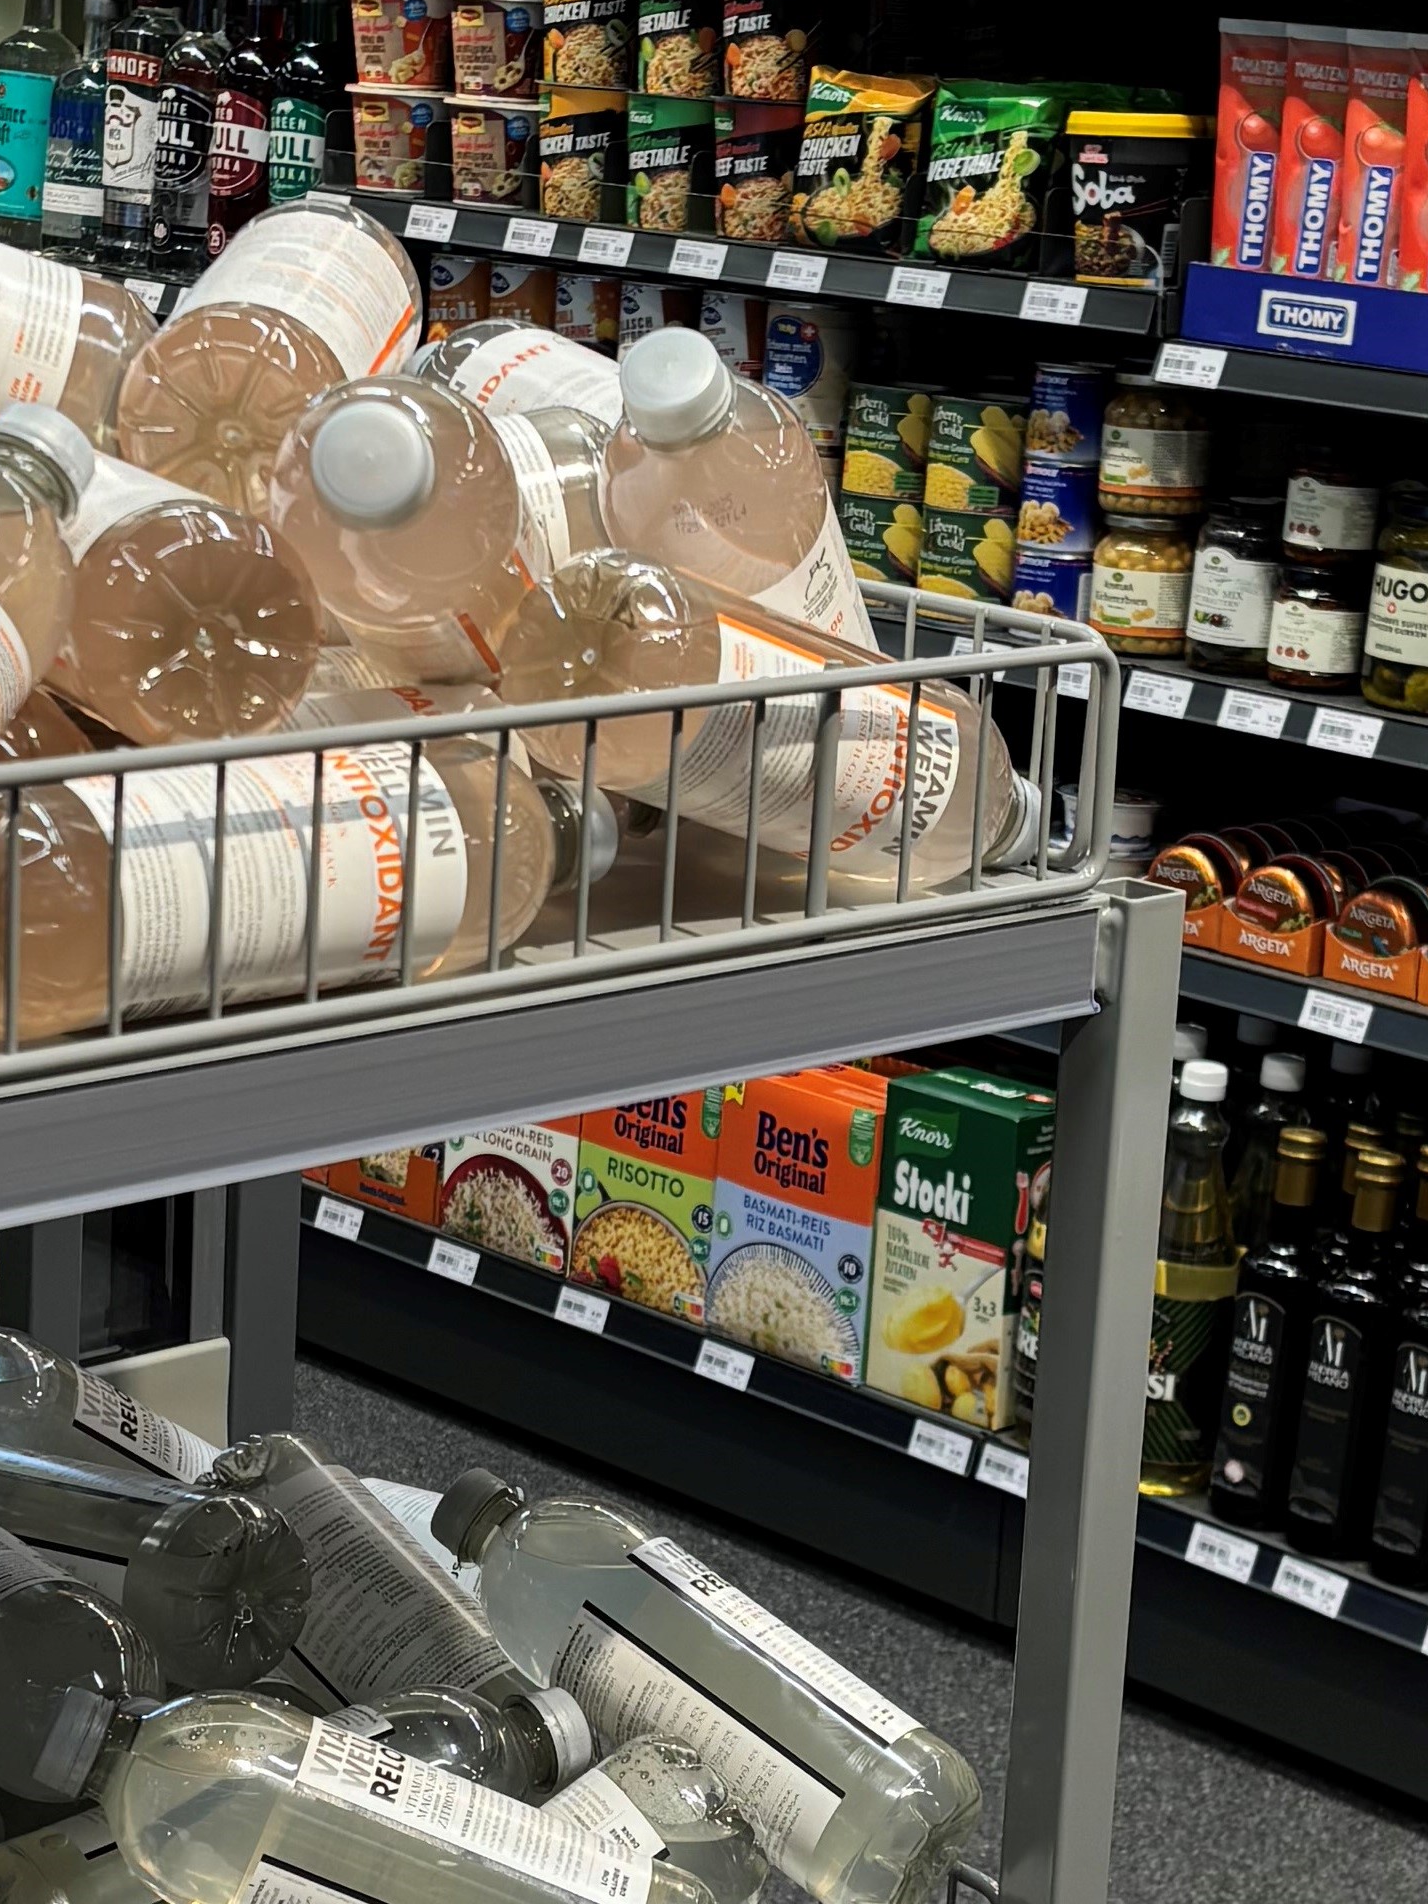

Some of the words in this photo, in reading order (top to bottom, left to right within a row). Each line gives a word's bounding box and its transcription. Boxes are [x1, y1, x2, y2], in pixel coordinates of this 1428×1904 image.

[738, 14, 772, 32] TASTE
[575, 130, 610, 150] TASTE
[799, 133, 862, 159] CHICKEN
[734, 154, 769, 175] TASTE
[797, 159, 829, 177] TASTE
[926, 149, 1004, 183] VEGETABLE
[1073, 162, 1136, 215] Soba
[1240, 153, 1274, 265] THOMY
[1298, 159, 1335, 274] THOMY
[1357, 167, 1393, 282] THOMY
[1271, 303, 1346, 332] THOMY
[1237, 929, 1289, 956] ARGETA
[1340, 955, 1394, 980] ARGETA
[613, 1112, 684, 1155] Original
[756, 1110, 830, 1171] Ben's
[898, 1117, 953, 1150] Knorr
[607, 1156, 685, 1198] RISOTTO
[753, 1150, 826, 1197] Original
[893, 1158, 970, 1226] Stocki
[742, 1193, 831, 1234] BASMATI-REIS
[746, 1213, 765, 1231] RIZ
[767, 1219, 825, 1252] BASMATI
